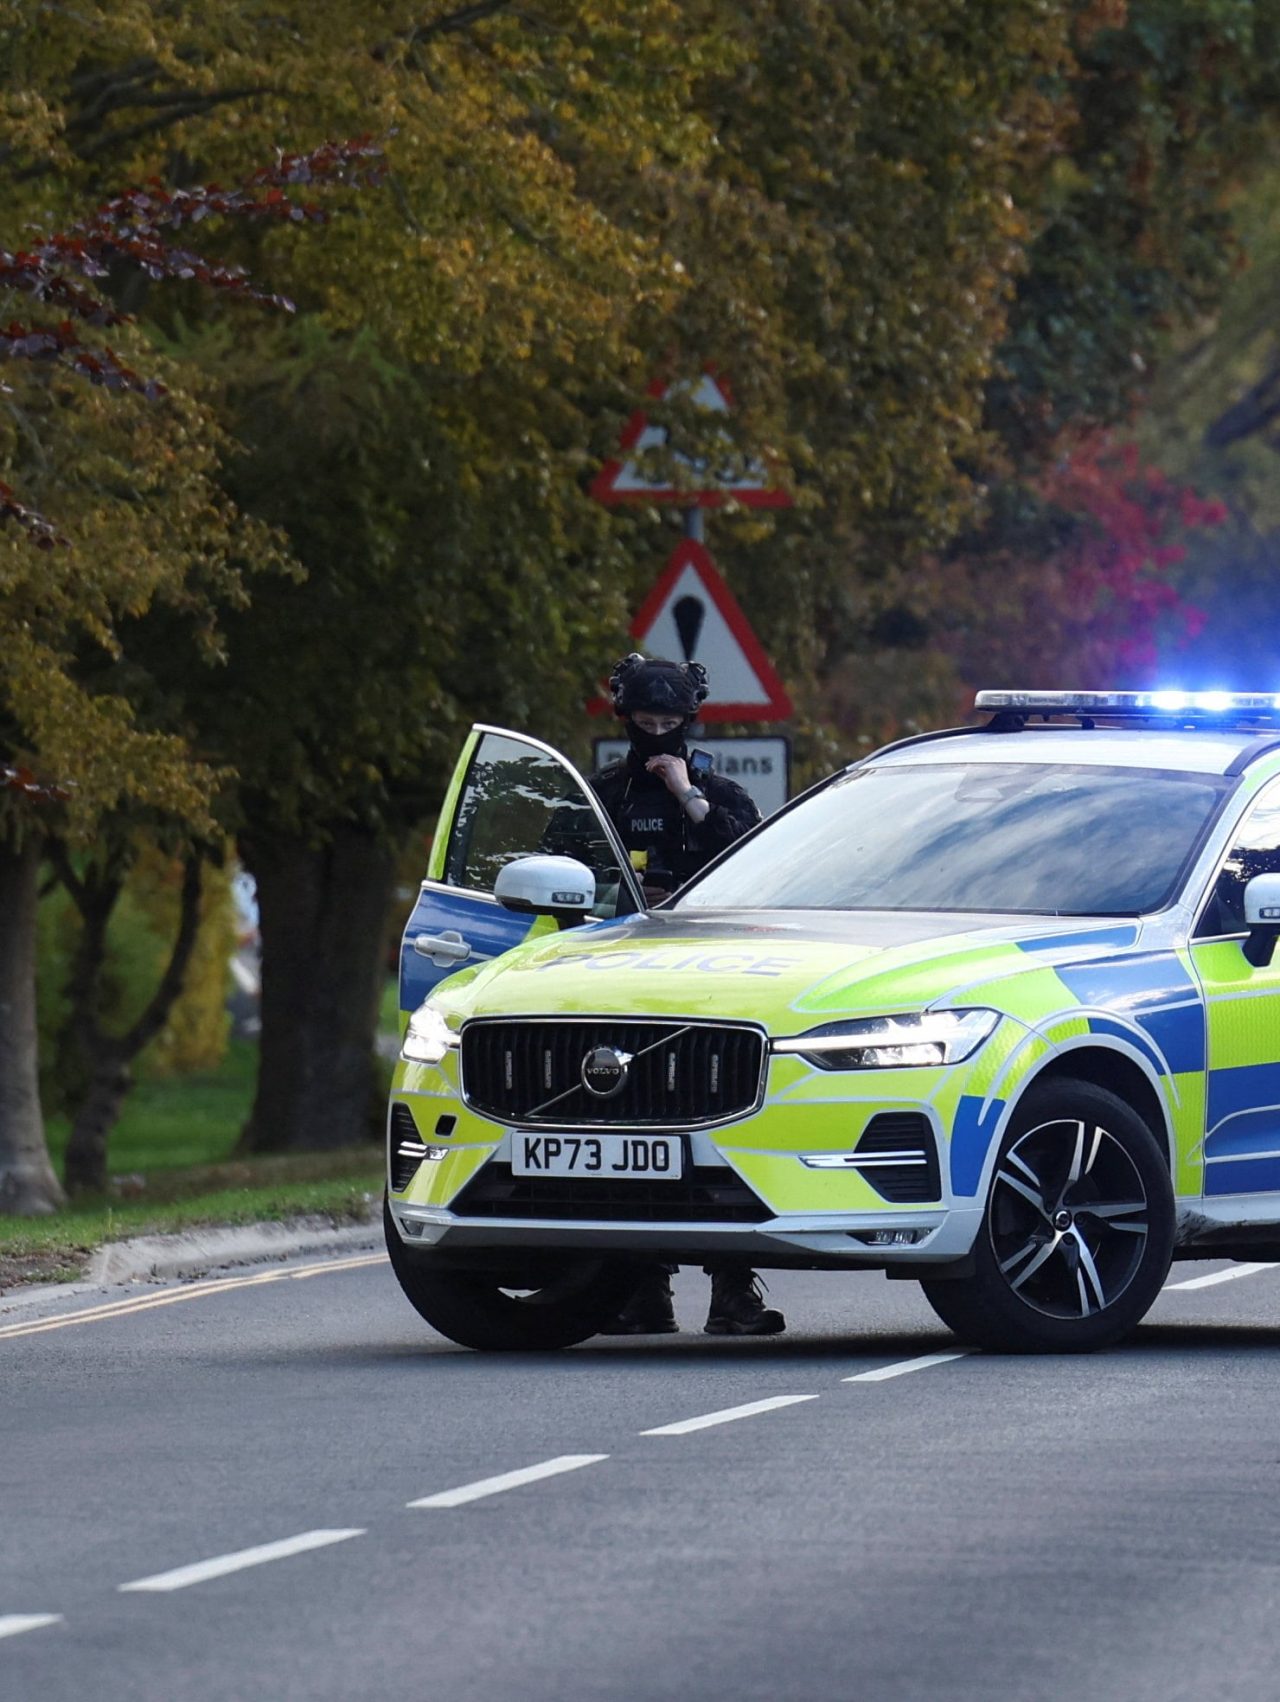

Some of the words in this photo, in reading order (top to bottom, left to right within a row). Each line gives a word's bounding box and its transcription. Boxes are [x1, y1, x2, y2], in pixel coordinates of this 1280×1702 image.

[631, 817, 664, 832] POLICE
[536, 952, 804, 977] POLICE
[586, 1066, 620, 1075] VOLVO
[524, 1137, 602, 1171] KP73
[611, 1139, 670, 1172] JDO
